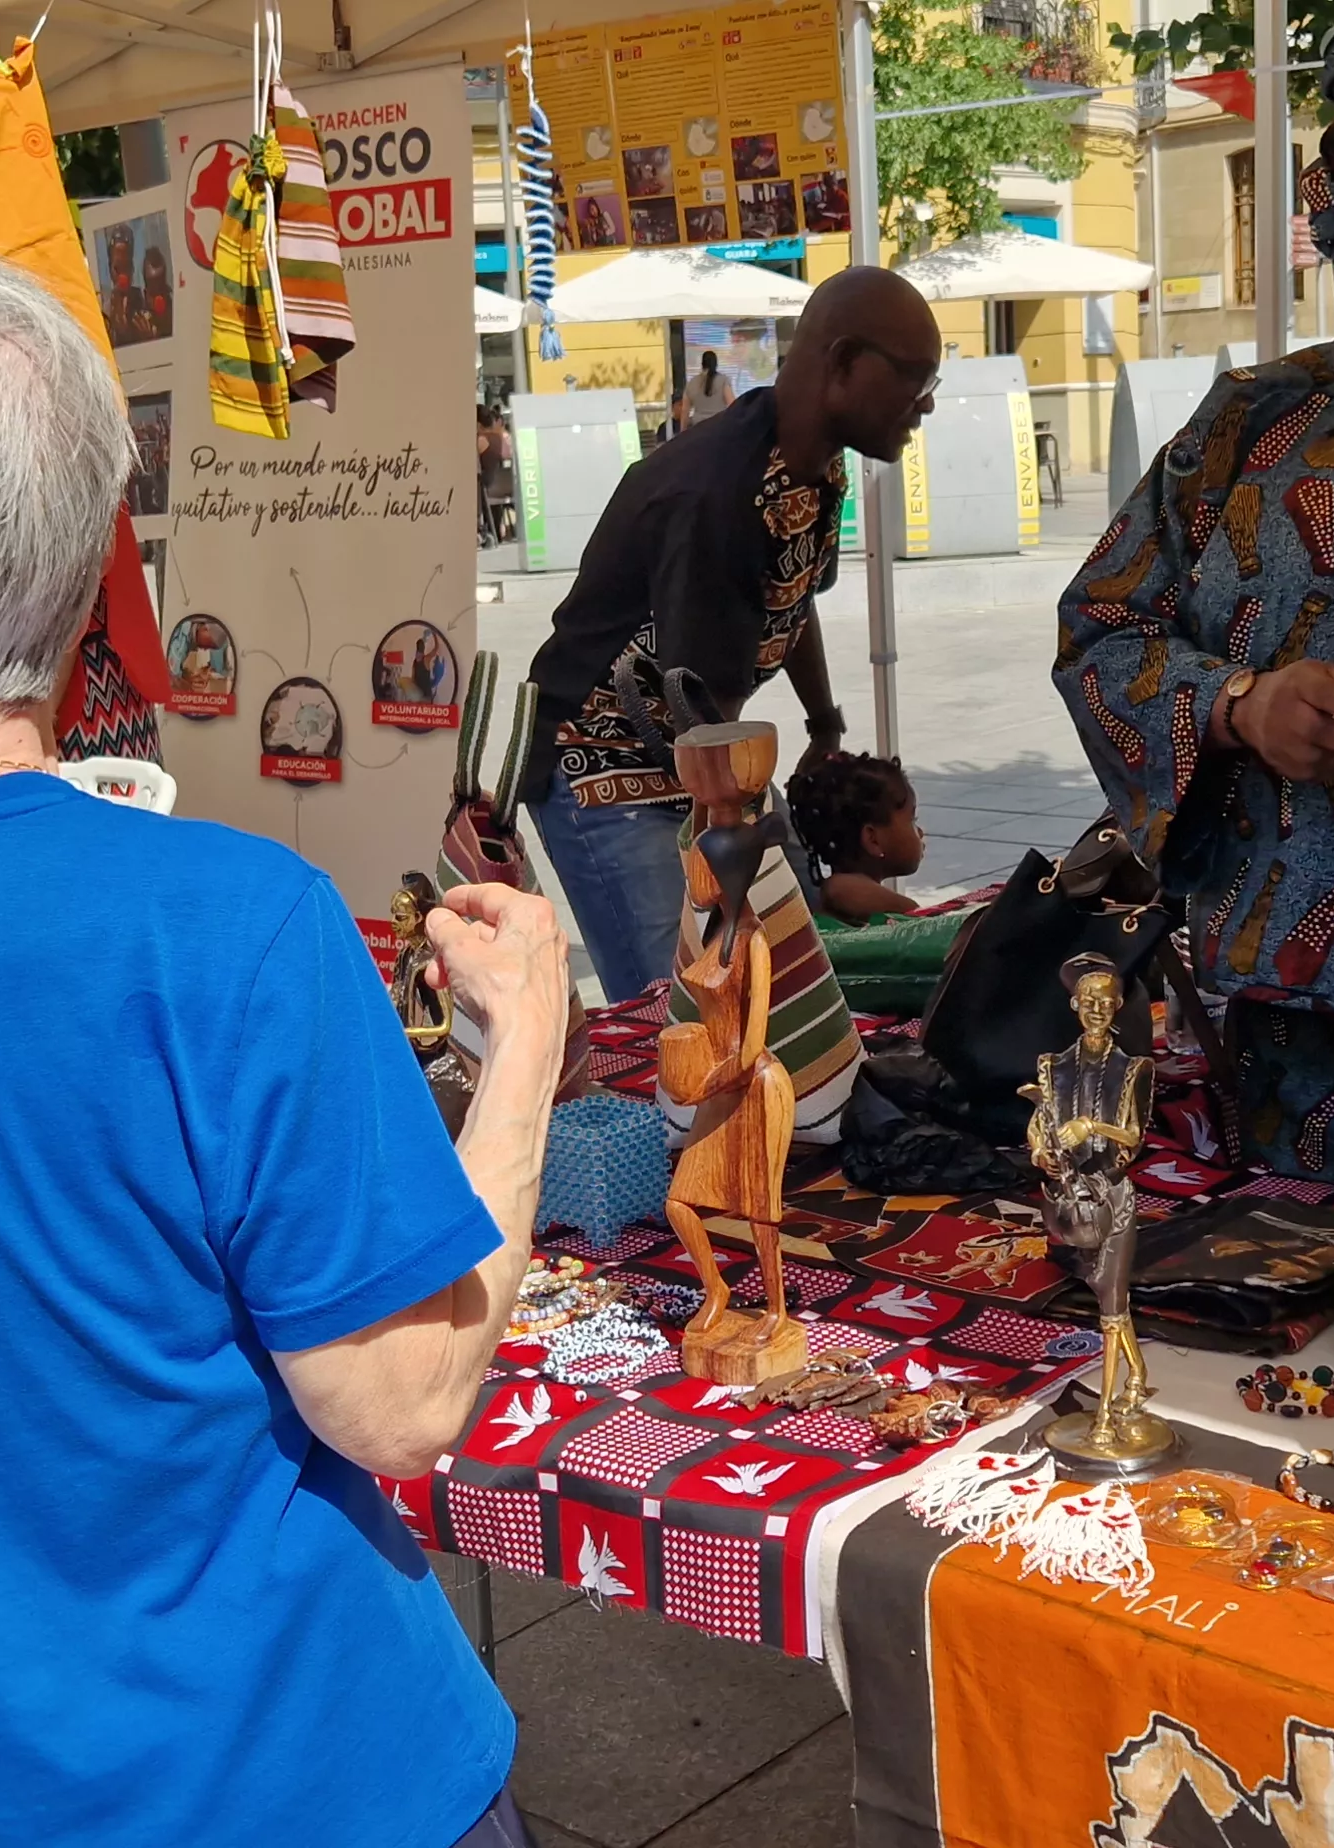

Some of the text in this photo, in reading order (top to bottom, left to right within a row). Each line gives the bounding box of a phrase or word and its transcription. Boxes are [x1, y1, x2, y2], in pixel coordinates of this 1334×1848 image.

[312, 102, 408, 133] TARACHEN
[324, 127, 431, 184] OSCO
[338, 187, 446, 243] OBAL
[190, 445, 234, 480] Por
[239, 462, 258, 478] un
[262, 441, 327, 478] mundo
[331, 449, 369, 481] más
[1013, 400, 1034, 508] ENVASES
[523, 445, 540, 520] VIDRIO
[905, 437, 924, 514] ENVAS
[253, 503, 269, 537] y
[171, 693, 228, 705] COOPERACIÓN
[380, 704, 450, 718] VOLUNTARIADO
[379, 714, 426, 724] INTERNACIONAL
[432, 717, 451, 726] LOCAL
[277, 757, 327, 771] EDUCACIÓN
